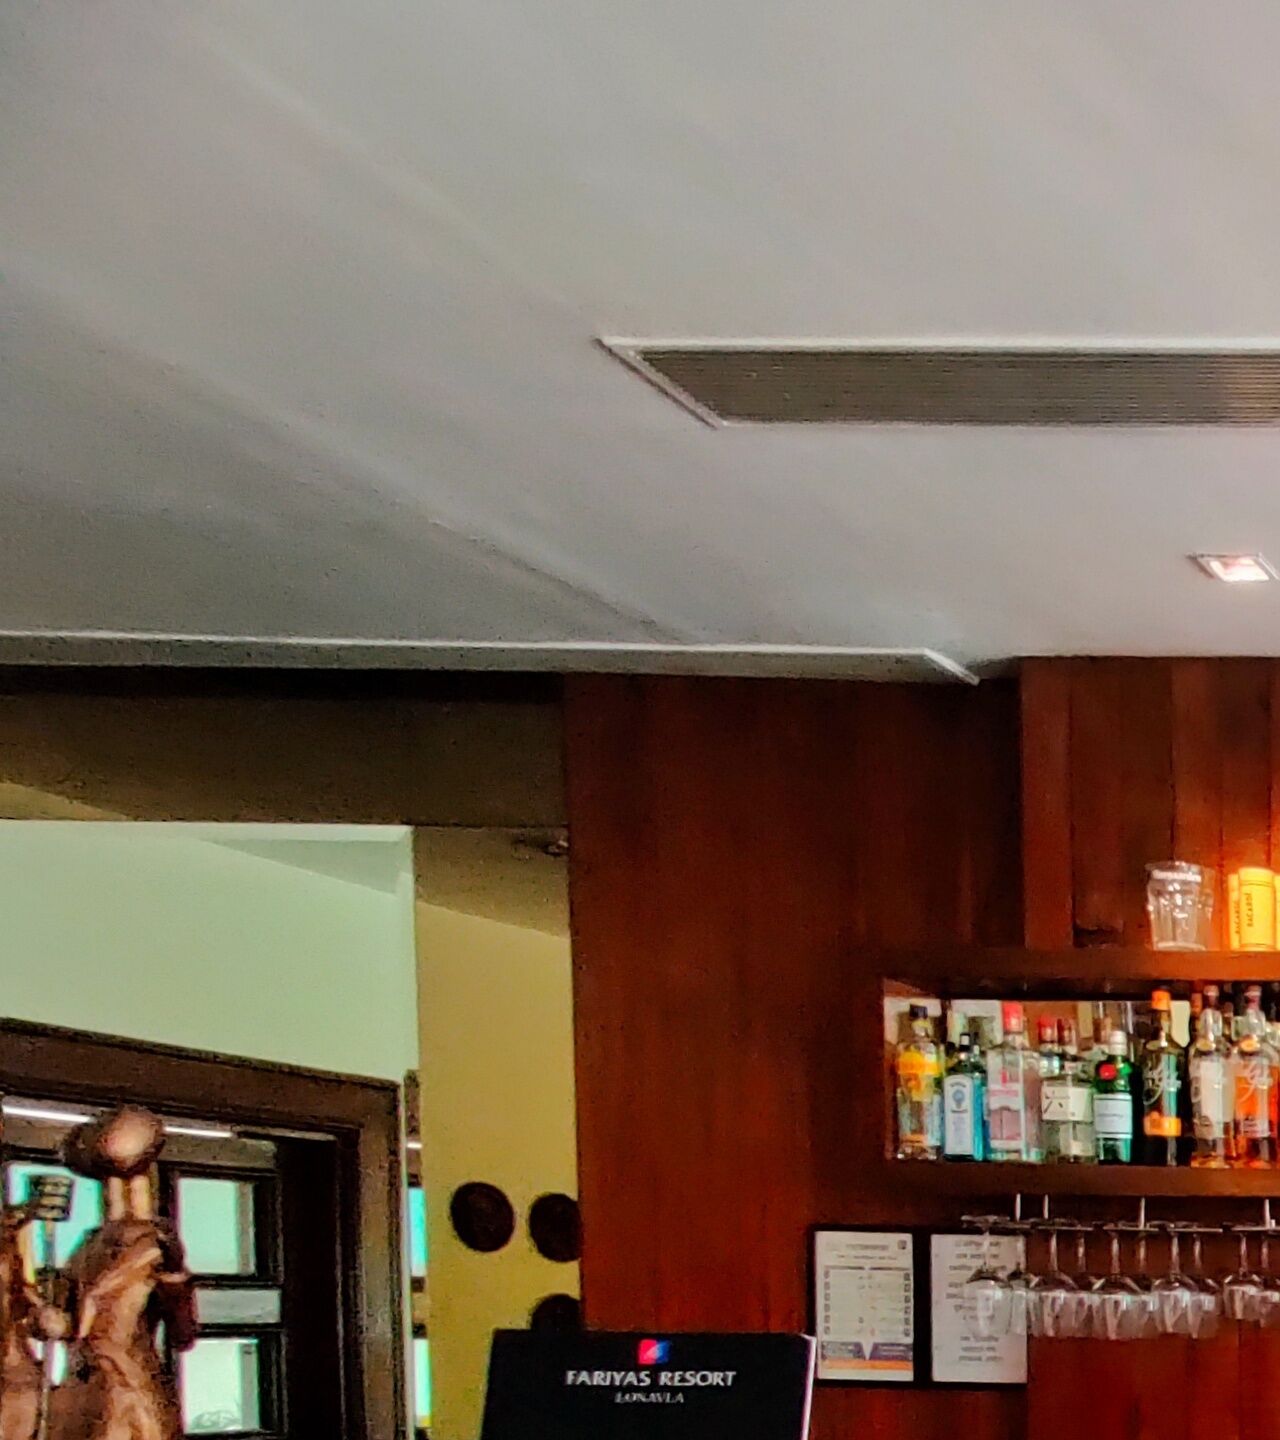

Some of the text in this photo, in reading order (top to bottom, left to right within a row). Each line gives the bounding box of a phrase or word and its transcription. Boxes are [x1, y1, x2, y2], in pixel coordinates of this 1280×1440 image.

[566, 1370, 737, 1387] FARIYAS RESORT
[614, 1391, 685, 1404] LONAVLA
